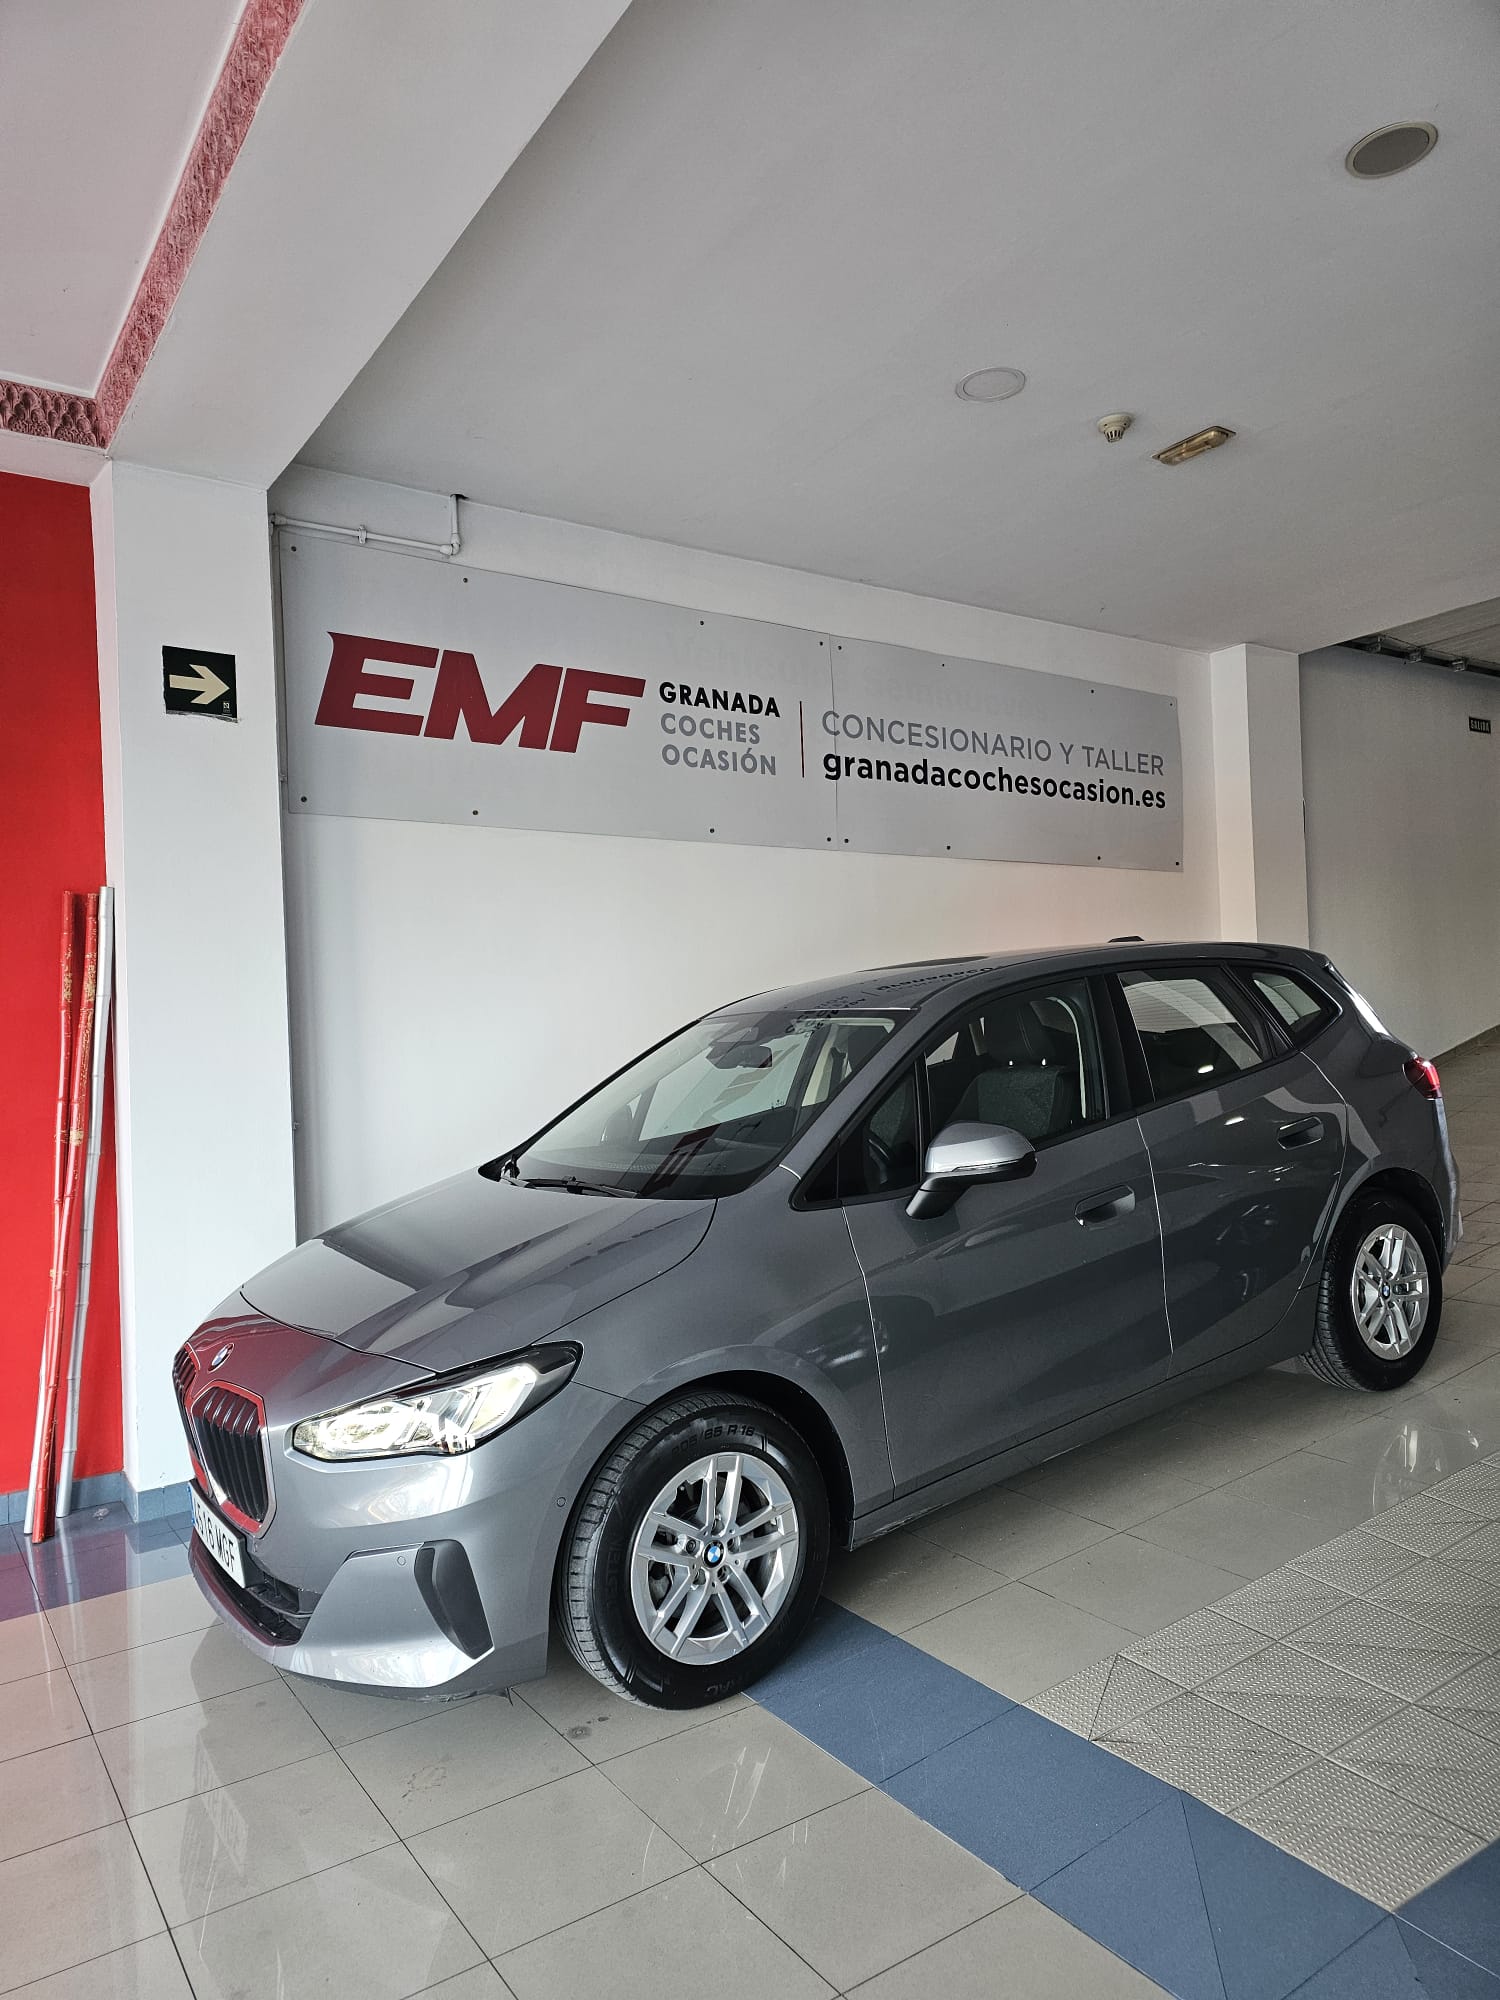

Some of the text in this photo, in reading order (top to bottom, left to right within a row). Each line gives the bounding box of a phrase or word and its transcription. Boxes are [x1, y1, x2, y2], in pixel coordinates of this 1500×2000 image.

[314, 631, 647, 754] EMF
[659, 681, 781, 718] GRANADA
[660, 712, 761, 745] COCHES
[821, 710, 1165, 776] CONCESIONARIO Y TALLER
[661, 743, 777, 776] OCASIÓN
[822, 752, 1167, 810] granadacochesocasion.es
